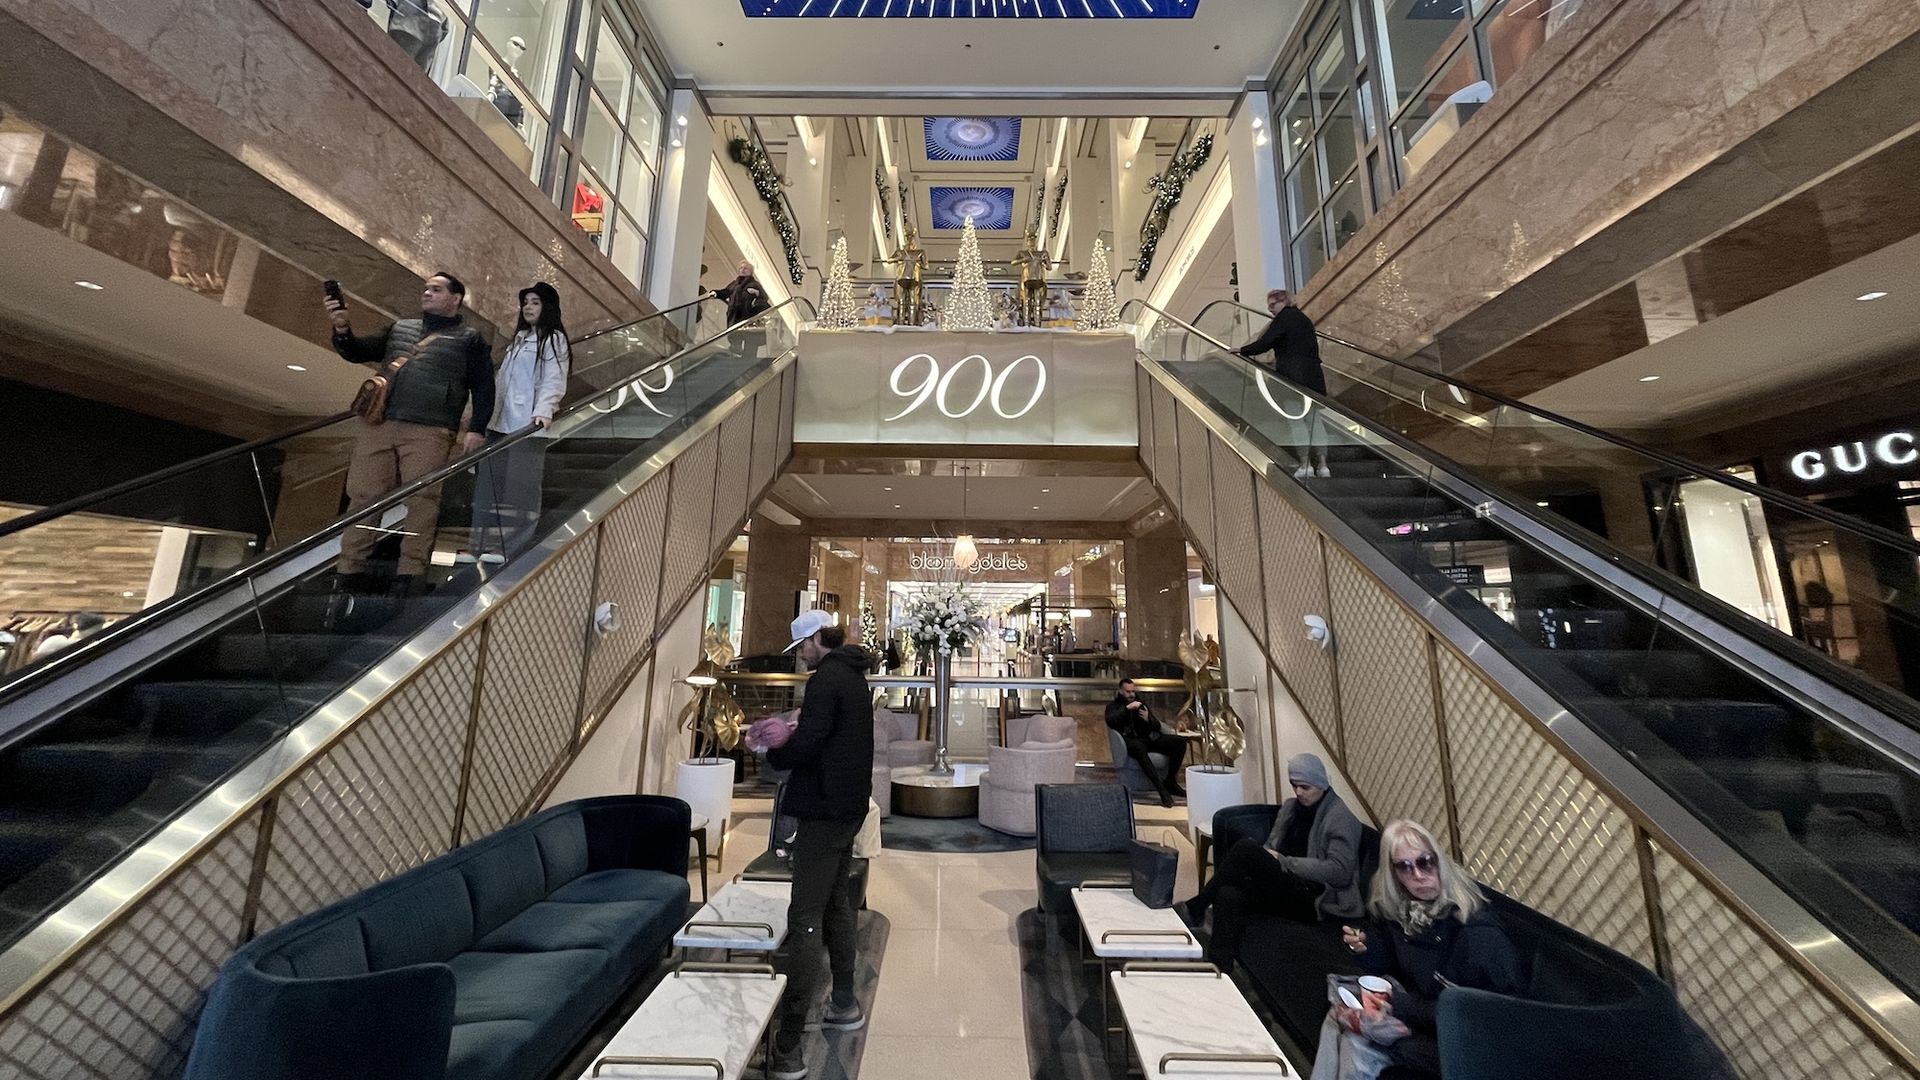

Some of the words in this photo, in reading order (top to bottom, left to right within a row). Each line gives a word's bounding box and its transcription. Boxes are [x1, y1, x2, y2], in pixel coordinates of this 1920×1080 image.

[884, 353, 1047, 422] 900
[1790, 432, 1919, 480] GUC
[910, 551, 1028, 574] bloomgdale's
